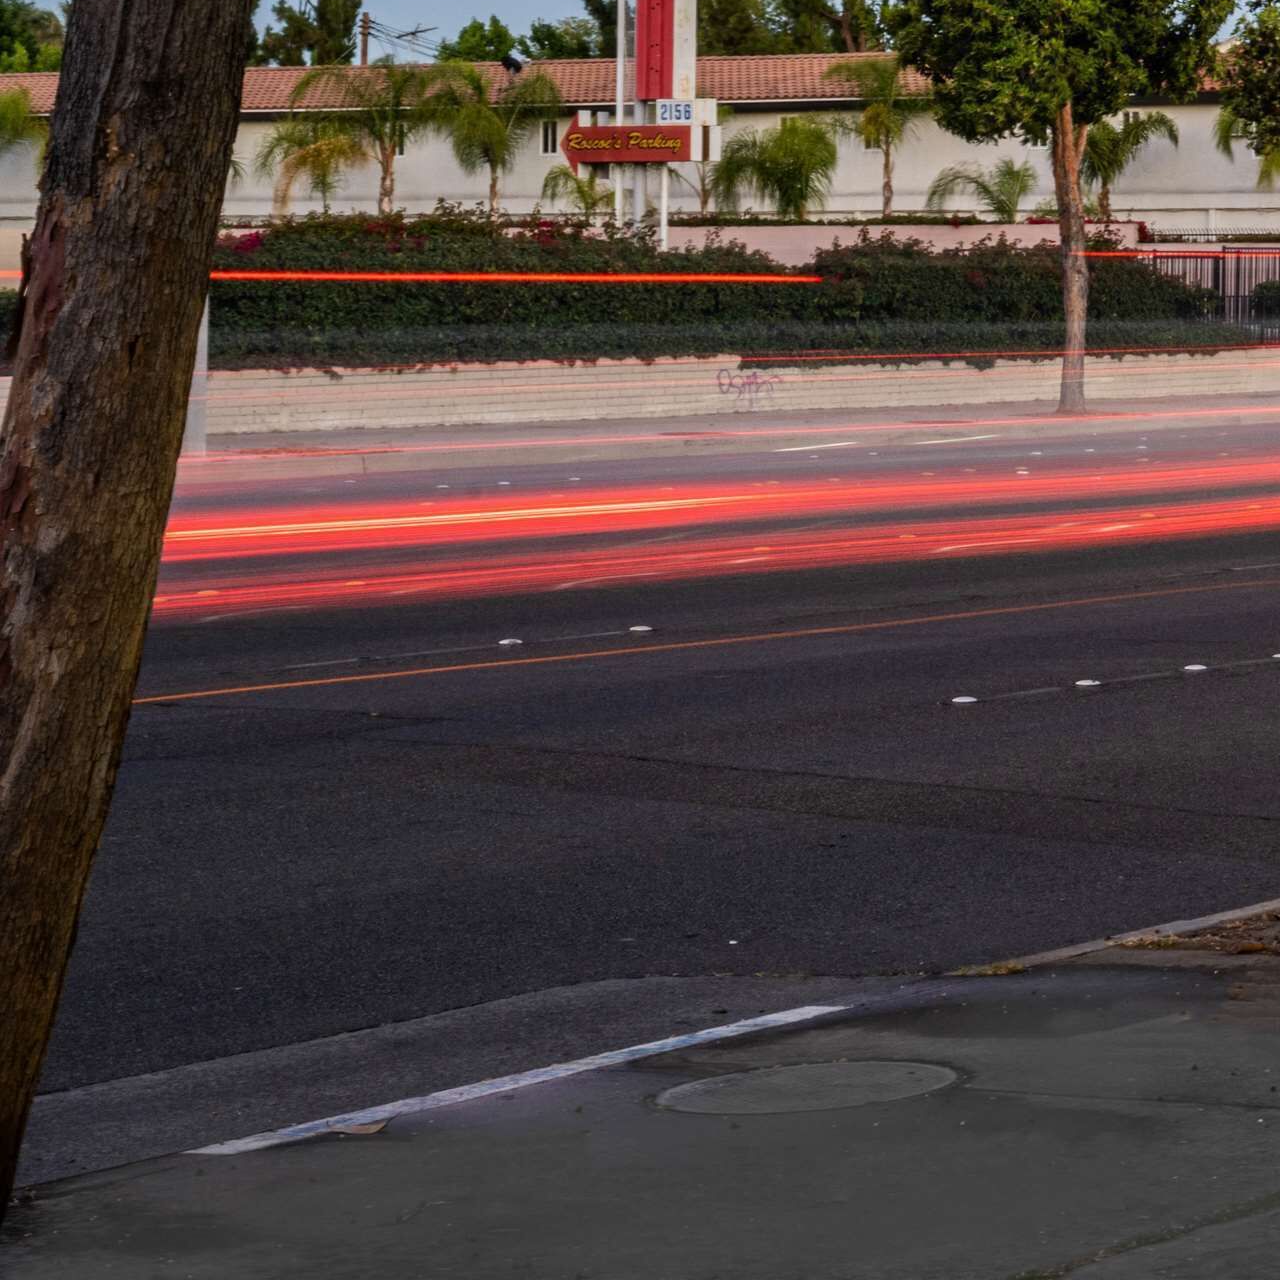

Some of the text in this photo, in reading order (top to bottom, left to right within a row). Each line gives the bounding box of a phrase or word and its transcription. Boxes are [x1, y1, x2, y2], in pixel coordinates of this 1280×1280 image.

[659, 103, 693, 121] 2156
[567, 131, 682, 153] Roscoe's Parking
